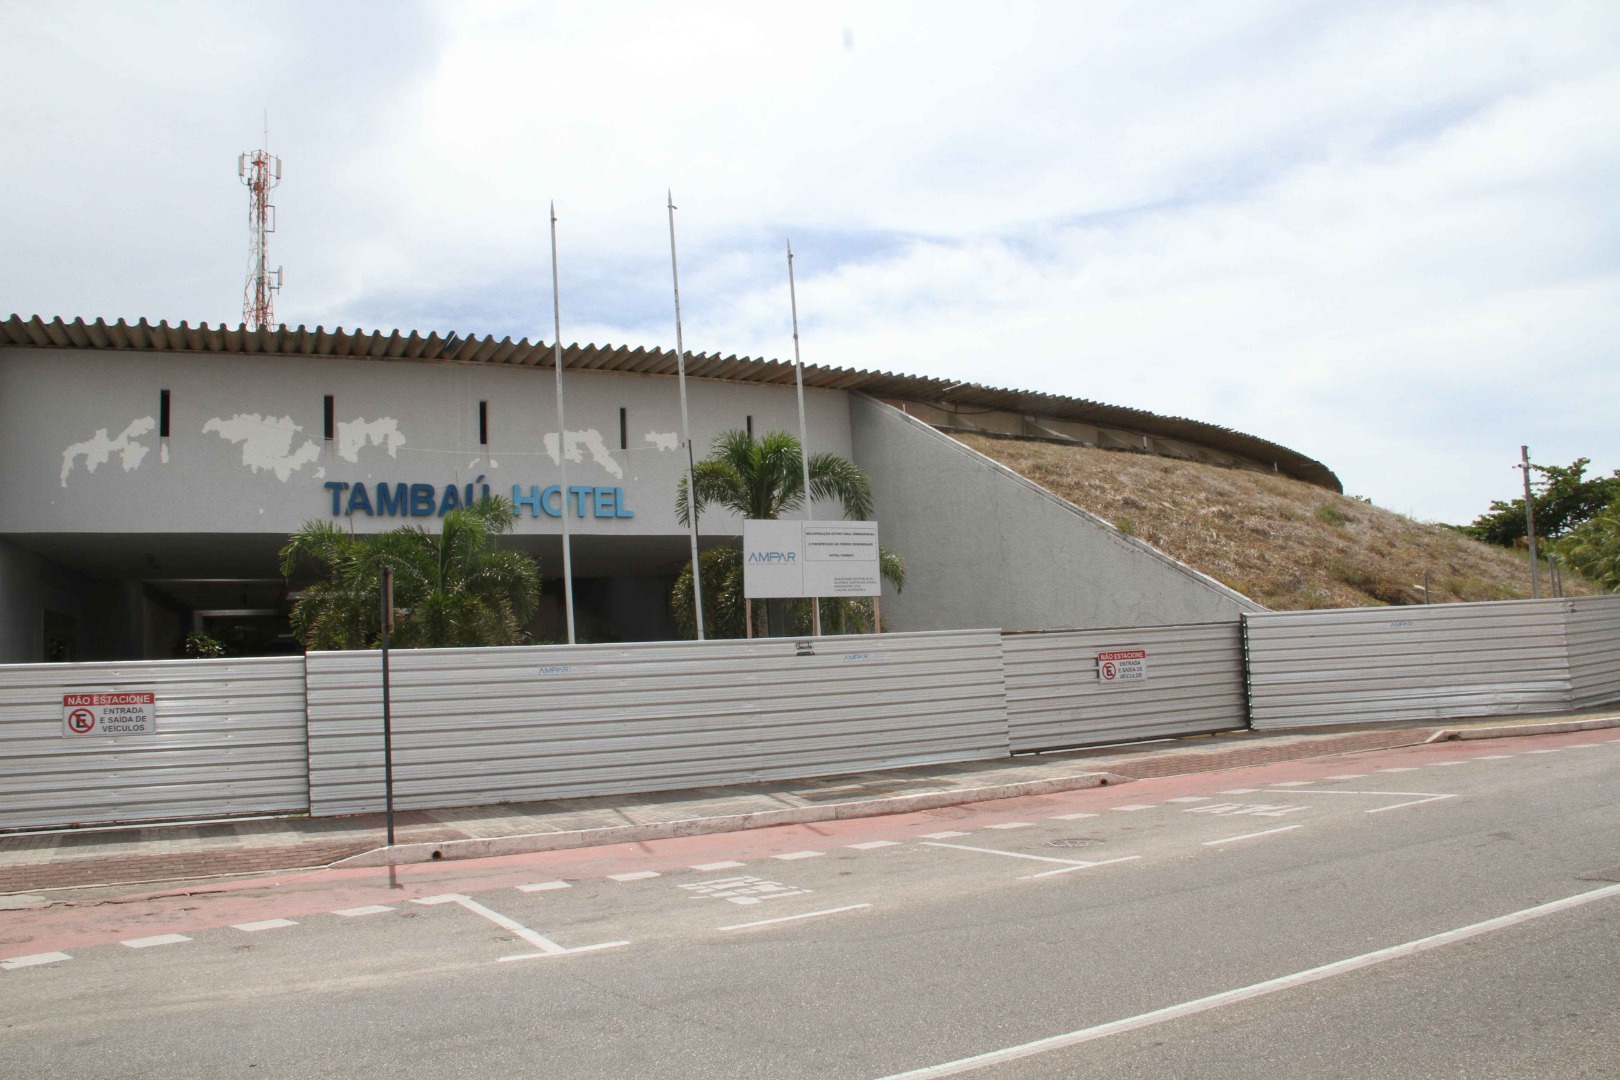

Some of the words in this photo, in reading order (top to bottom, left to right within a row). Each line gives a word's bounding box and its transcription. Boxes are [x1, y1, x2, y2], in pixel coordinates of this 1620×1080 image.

[512, 484, 635, 519] HOTEL
[748, 552, 796, 562] AMPAR
[67, 696, 90, 706] NÃO
[93, 694, 150, 705] ESTACIONE
[103, 707, 144, 715] ENTRADA
[107, 715, 134, 723] SAÍDA
[102, 724, 145, 733] VEÍCULOS
